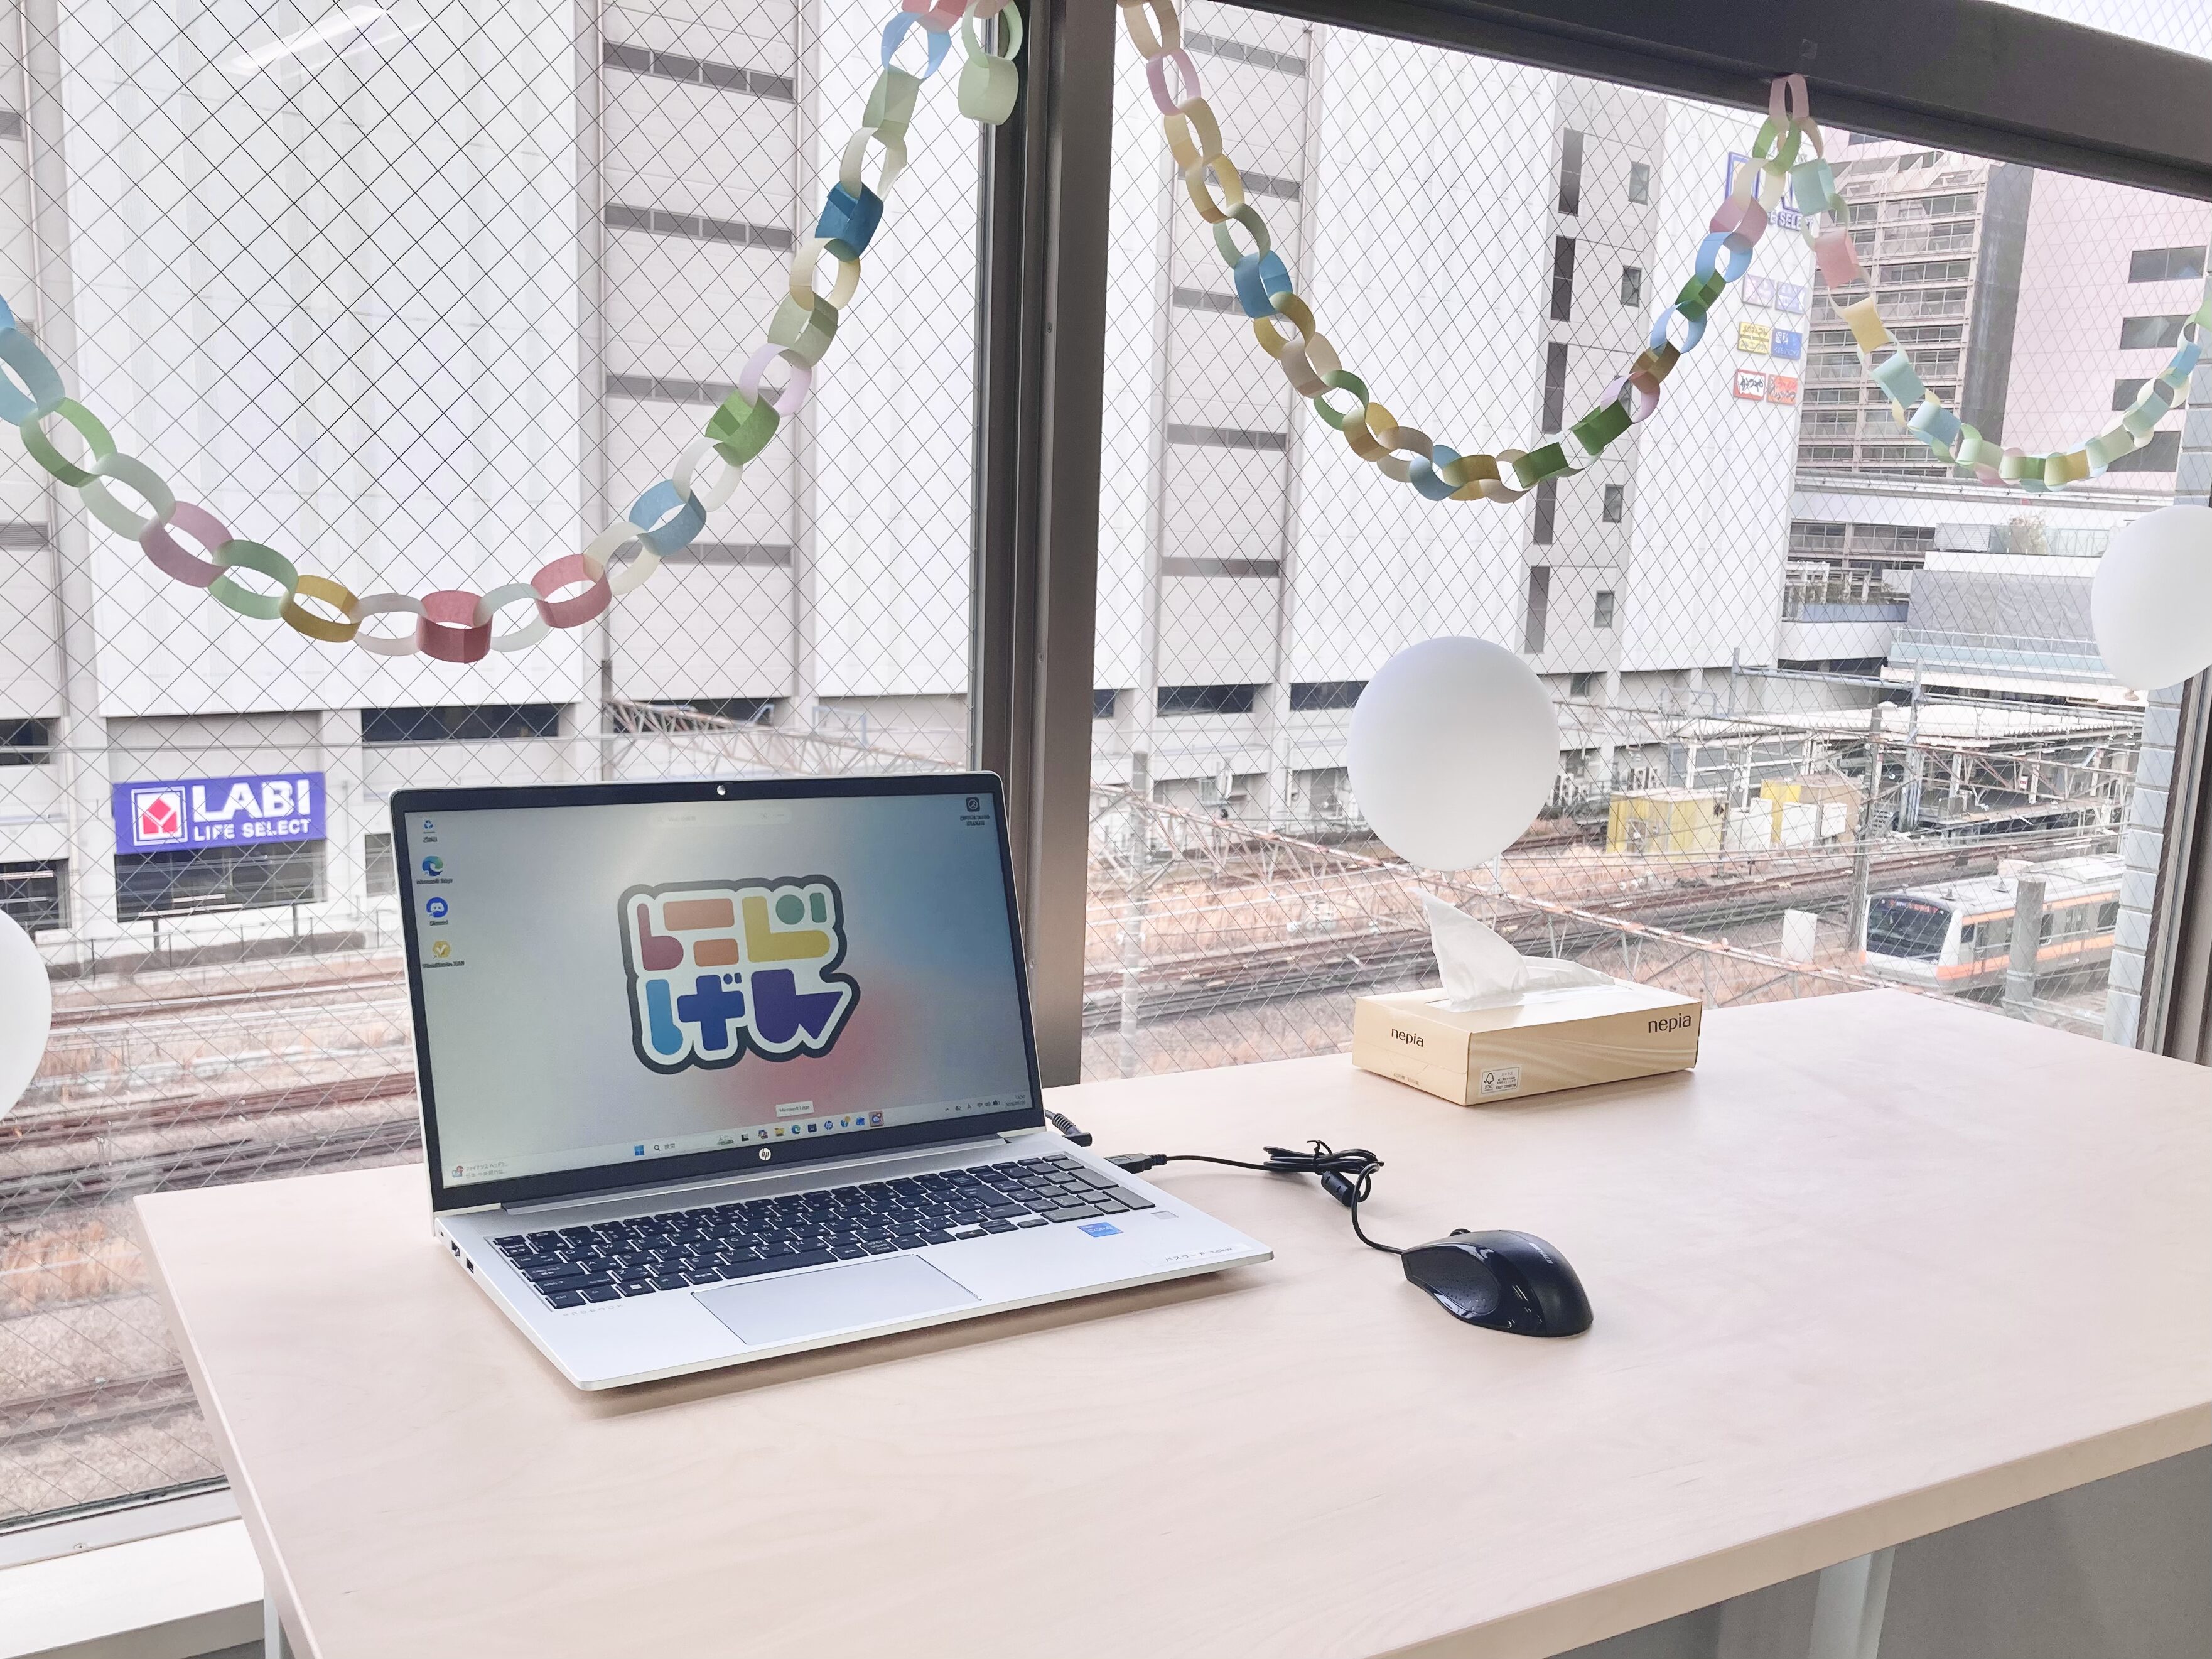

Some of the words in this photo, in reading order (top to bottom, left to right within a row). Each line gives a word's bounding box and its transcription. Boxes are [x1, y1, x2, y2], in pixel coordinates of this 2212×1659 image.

[1740, 376, 1764, 392] かつや
[192, 779, 311, 823] LABI
[193, 824, 235, 842] LIFE
[242, 819, 311, 838] SELECT
[1648, 1012, 1692, 1034] nepia
[1391, 1027, 1424, 1047] nepia
[760, 1148, 770, 1160] hp
